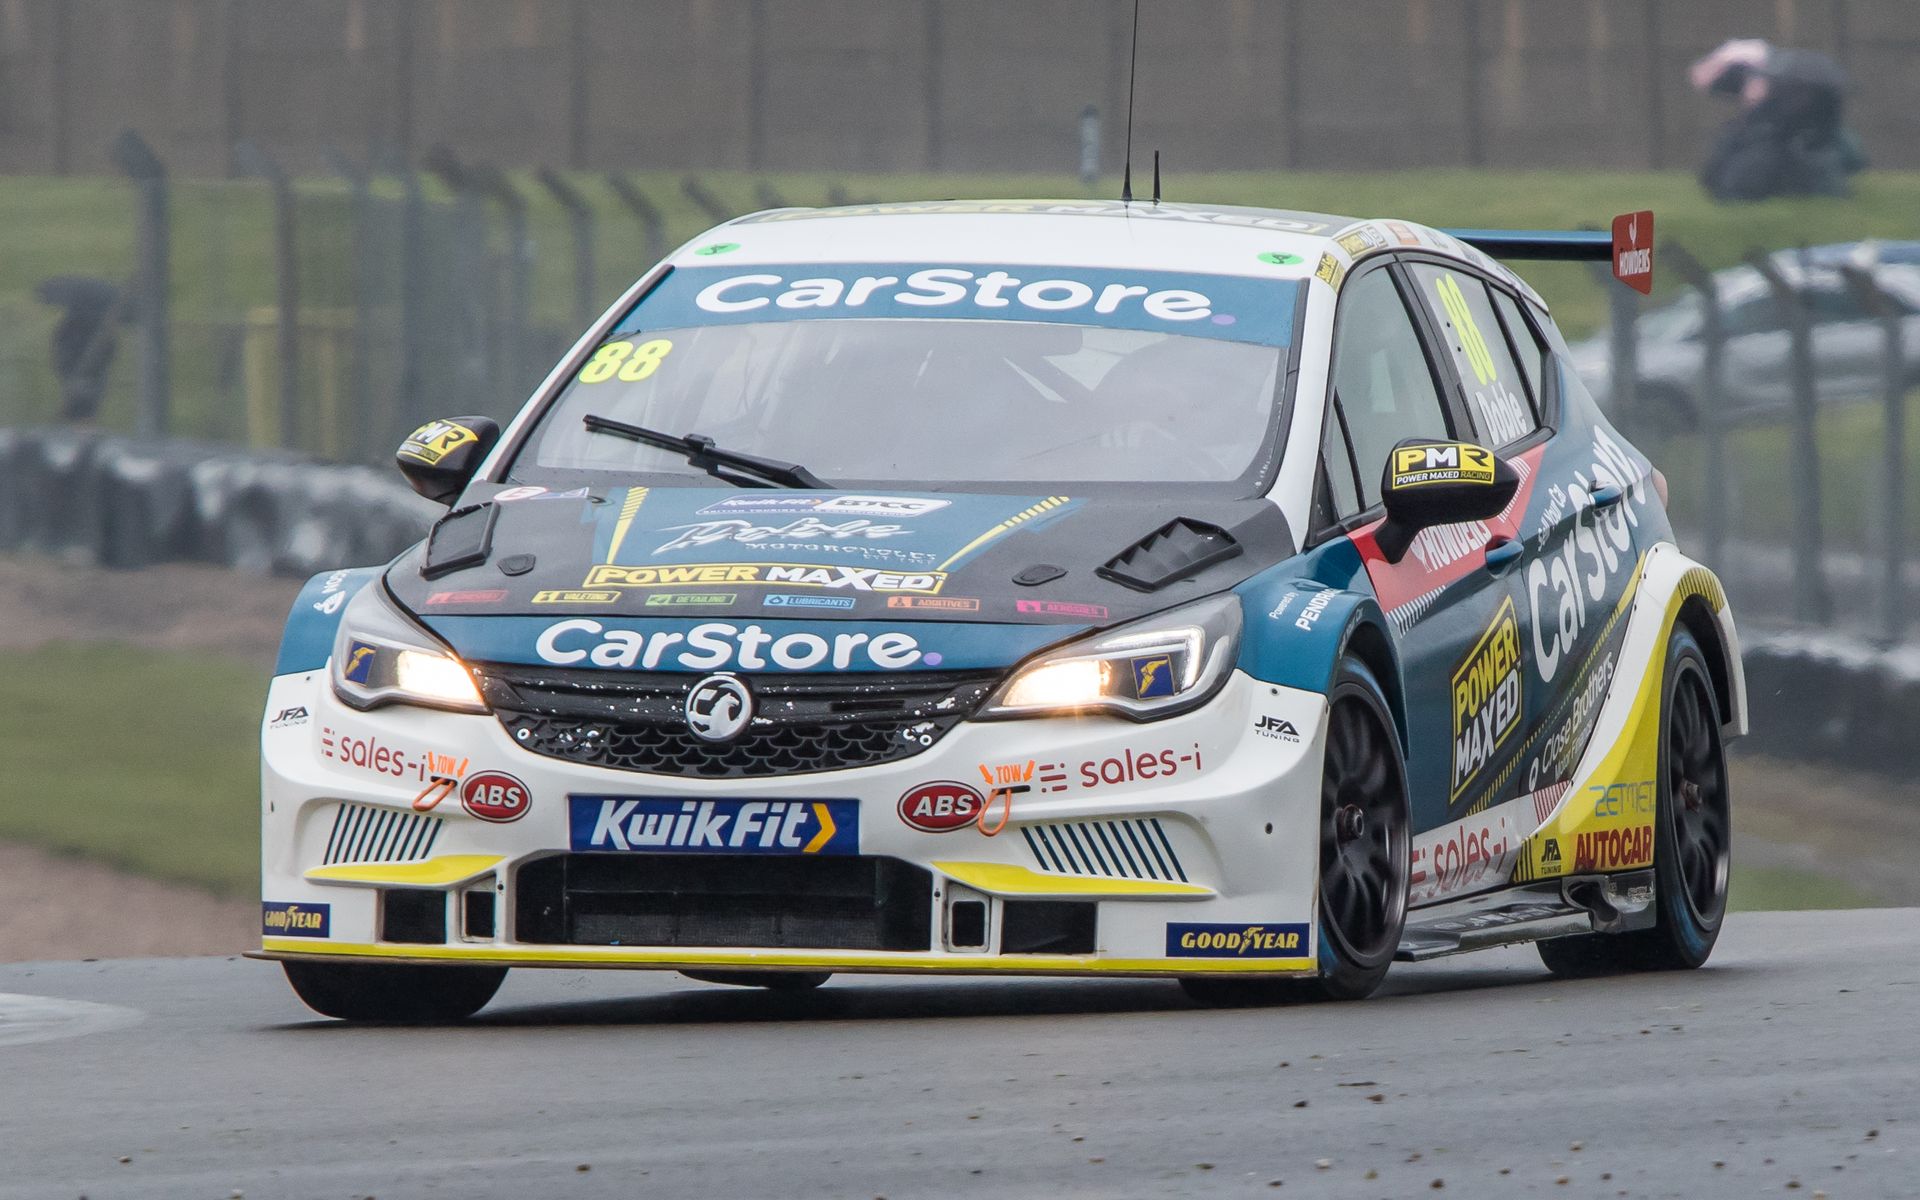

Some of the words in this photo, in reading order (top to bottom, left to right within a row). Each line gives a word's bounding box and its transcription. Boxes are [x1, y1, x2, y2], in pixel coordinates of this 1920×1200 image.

[1619, 248, 1650, 277] HOWDENS
[1436, 272, 1497, 386] 88
[579, 339, 673, 384] 88
[1398, 446, 1490, 473] PMR
[1396, 472, 1429, 485] POWER
[1429, 470, 1460, 481] MAXED
[1460, 471, 1491, 480] RACING
[834, 499, 926, 510] BTCC
[744, 543, 936, 560] MOTORCYCLES
[593, 566, 760, 584] POWER
[765, 566, 937, 591] MAXED
[563, 592, 609, 601] VALETING
[675, 595, 726, 603] DETAILING
[788, 597, 851, 607] LUBRICANTS
[916, 599, 970, 609] ADDITIVES
[1455, 616, 1518, 736] POWER
[271, 706, 309, 723] JFA
[1542, 717, 1572, 774] Close
[1571, 651, 1614, 735] Brothers
[1254, 715, 1300, 737] JFA
[1254, 729, 1301, 744] TUNING
[1454, 668, 1519, 789] MAXED
[339, 736, 427, 782] sales-i
[437, 754, 456, 775] TOW
[1079, 742, 1202, 788] sales-i
[995, 764, 1022, 784] TOW
[471, 783, 521, 809] ABS
[912, 793, 974, 818] ABS
[1541, 837, 1562, 861] JFA
[1574, 825, 1653, 873] AUTOCAR
[1540, 864, 1562, 875] TUNING
